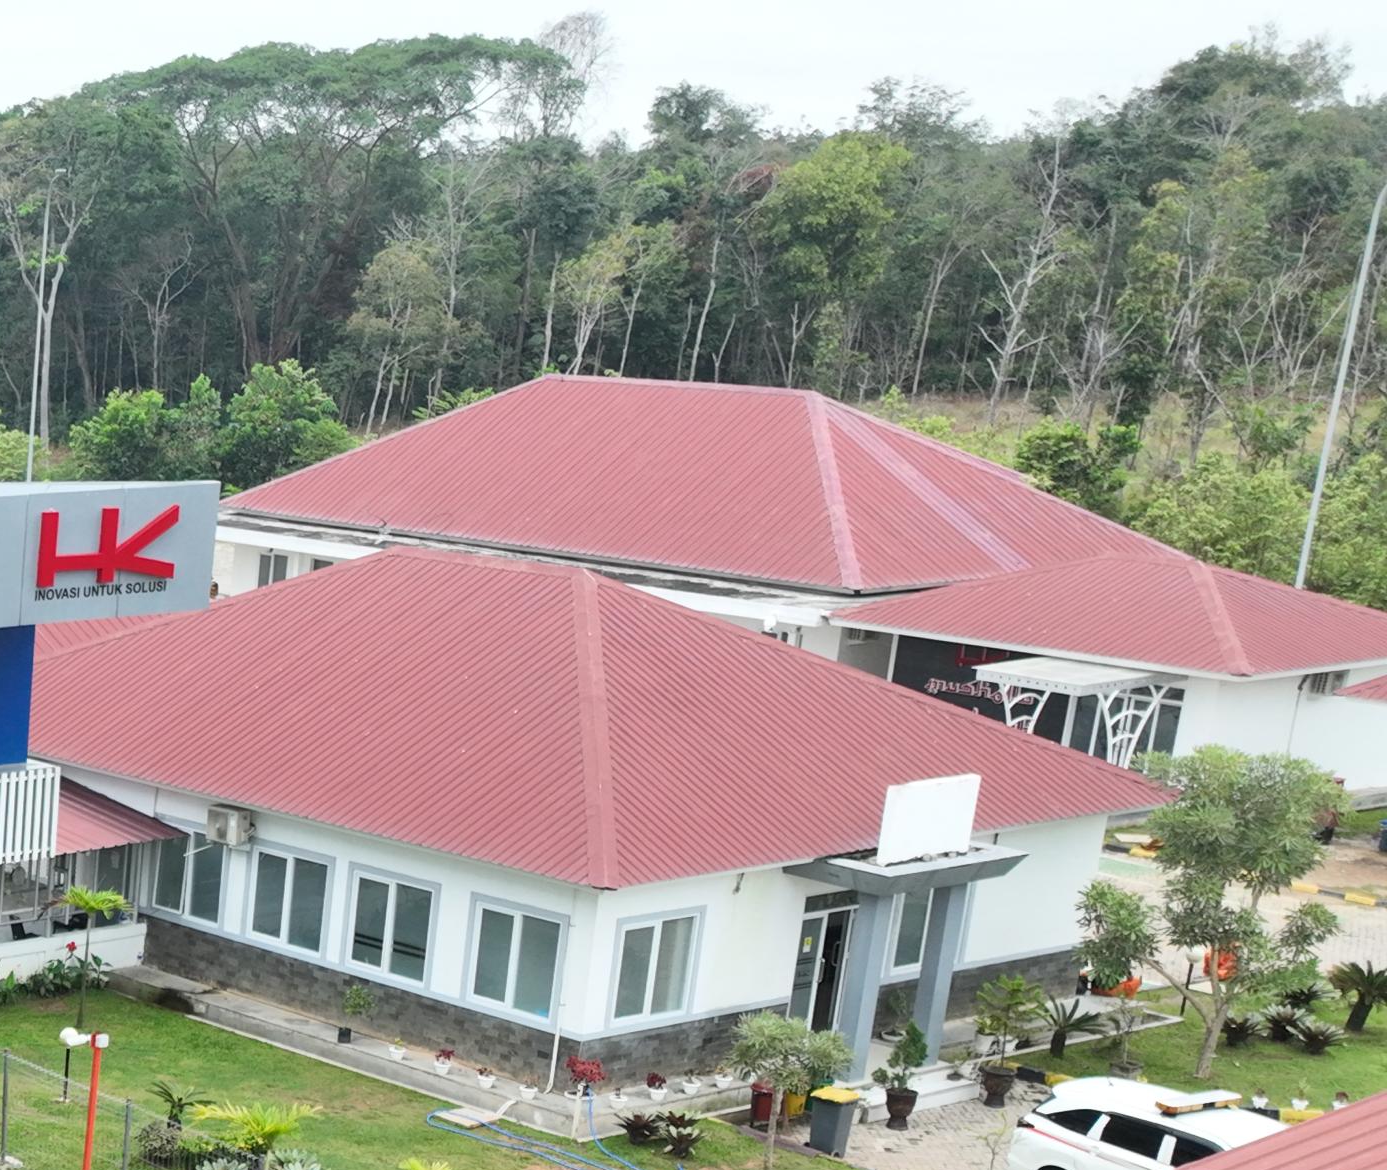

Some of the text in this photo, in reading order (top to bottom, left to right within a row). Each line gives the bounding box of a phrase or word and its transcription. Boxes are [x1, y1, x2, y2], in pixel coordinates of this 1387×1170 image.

[36, 504, 180, 588] HK
[35, 580, 168, 602] INOVASI UNTUK SOLUSI
